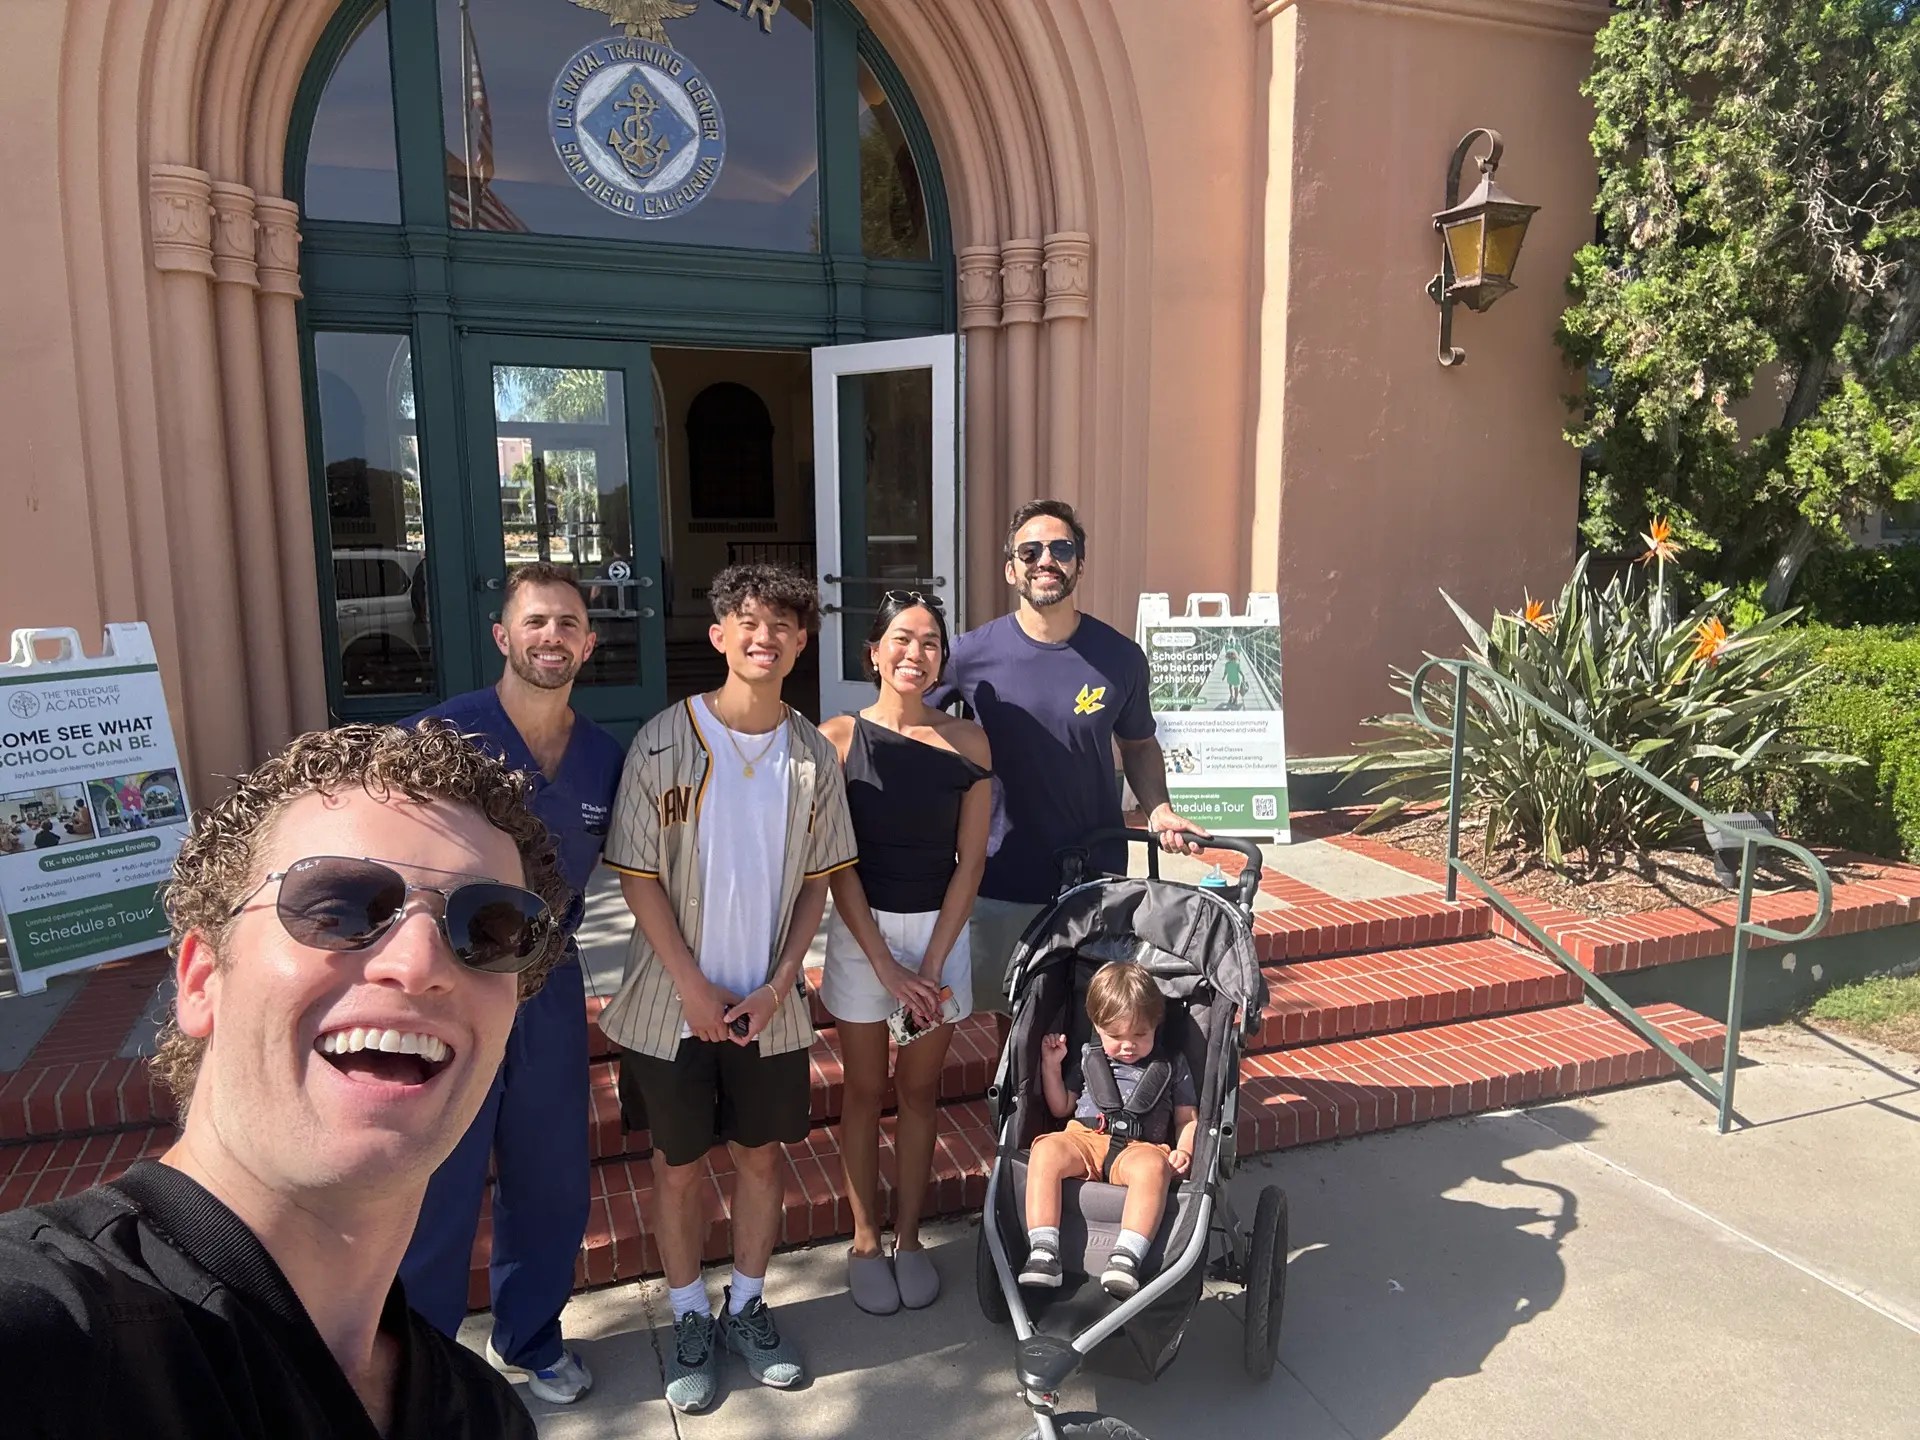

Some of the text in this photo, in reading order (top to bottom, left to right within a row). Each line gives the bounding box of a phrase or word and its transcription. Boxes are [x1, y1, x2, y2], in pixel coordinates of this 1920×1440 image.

[562, 50, 604, 96] NAVAL
[605, 43, 682, 76] TRAINING
[685, 77, 719, 141] CENTER
[561, 143, 589, 175] SAN
[644, 156, 717, 214] CALIFORNIA
[1152, 652, 1217, 661] School can be
[1153, 664, 1213, 674] the best part
[1153, 675, 1165, 683] of
[1165, 675, 1187, 683] their
[41, 685, 120, 700] THE TREEHOUSE
[45, 694, 121, 713] ACADEMY
[0, 716, 153, 748] OME SEE WHAT
[1237, 720, 1268, 728] community
[82, 738, 122, 756] CAN
[129, 735, 157, 750] BE.
[69, 762, 95, 773] learning
[95, 760, 105, 768] for
[656, 785, 693, 827] AN
[1172, 802, 1213, 812] chedule
[1222, 802, 1244, 812] Tour
[44, 860, 55, 868] TK
[61, 856, 75, 866] 8th
[75, 852, 99, 863] Grade
[107, 848, 124, 856] Now
[125, 840, 157, 852] Enrolling
[27, 871, 101, 892] Individualized Learning
[25, 902, 114, 927] Limited openings available
[29, 907, 150, 946] Schedule a Tour
